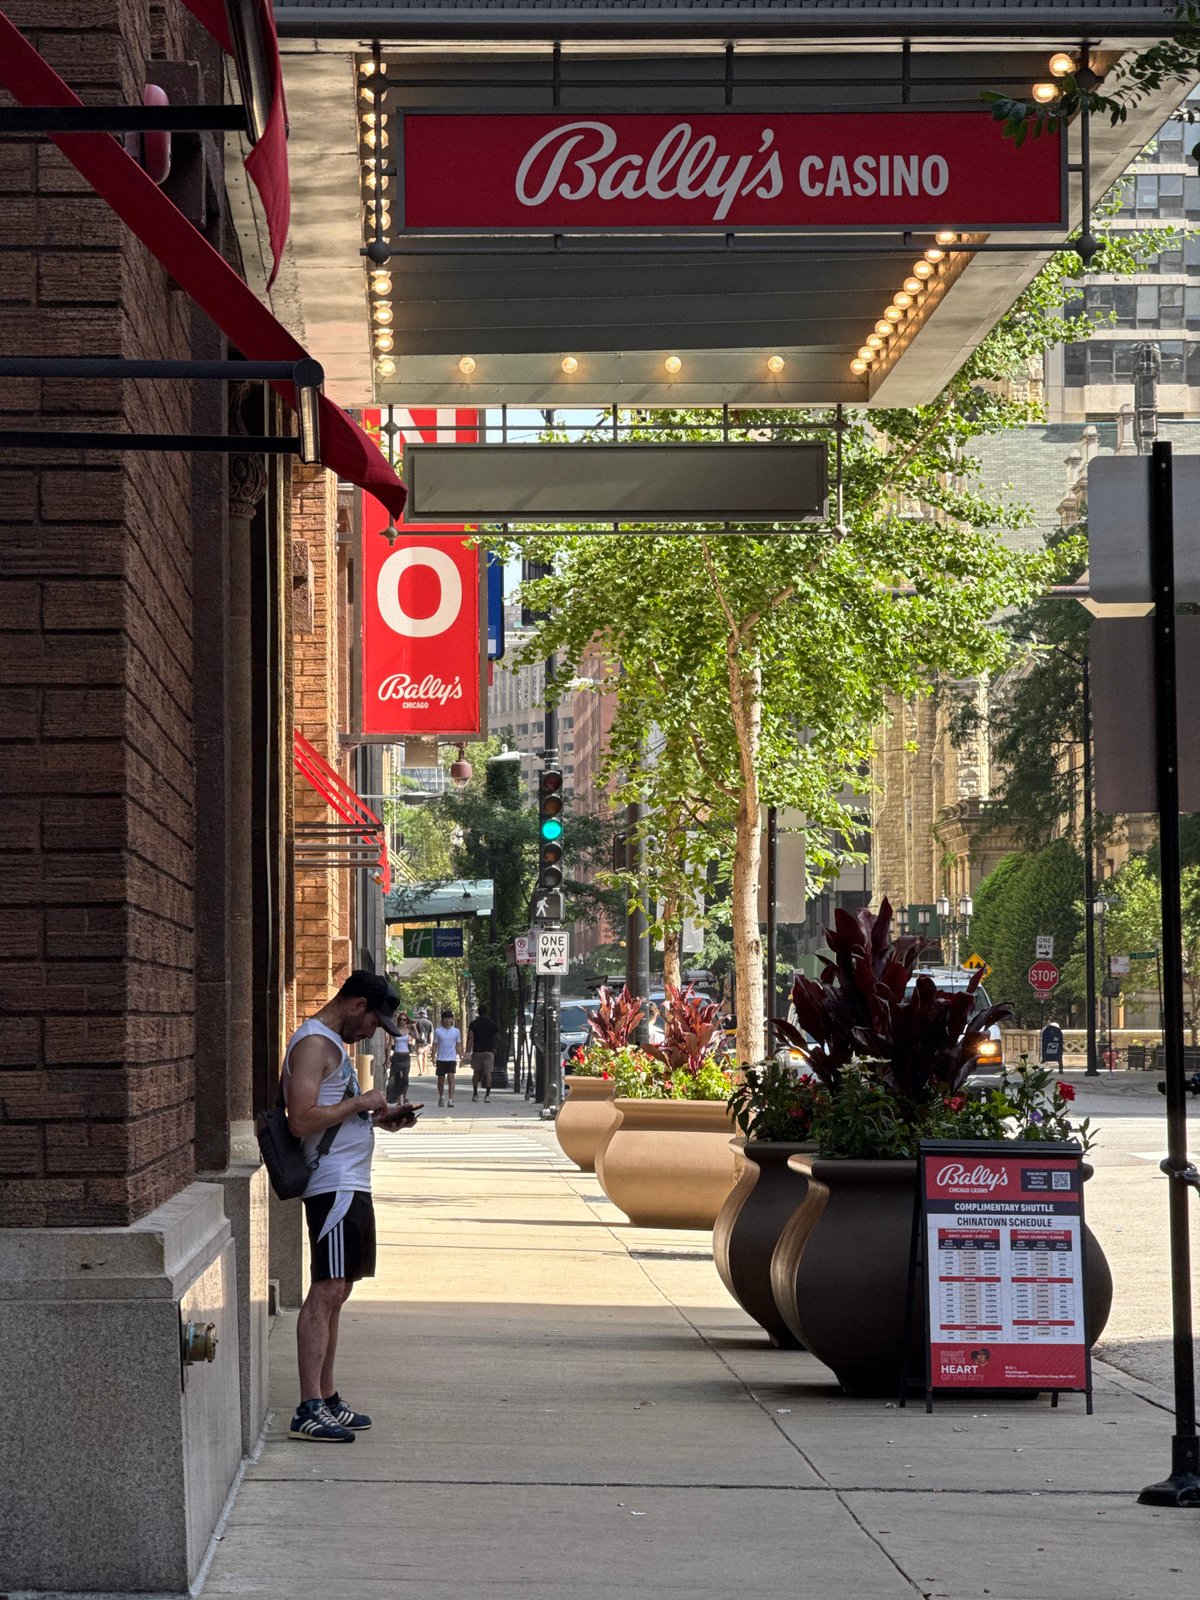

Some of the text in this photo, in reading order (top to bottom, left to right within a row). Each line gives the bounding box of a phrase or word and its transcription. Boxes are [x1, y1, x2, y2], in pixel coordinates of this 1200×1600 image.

[514, 120, 950, 221] Bally's CASINO
[377, 673, 463, 706] Bally's
[402, 701, 429, 709] CHICAGO
[436, 940, 461, 948] Express
[541, 935, 565, 946] ONE
[540, 947, 565, 957] WAY
[1031, 970, 1057, 982] STOP
[936, 1163, 1009, 1191] Bally's
[954, 1202, 1055, 1212] COMPLIMENTARY SHUTTLE
[957, 1217, 1053, 1227] CHINATOWN SCHEDULE
[941, 1364, 979, 1374] HEART
